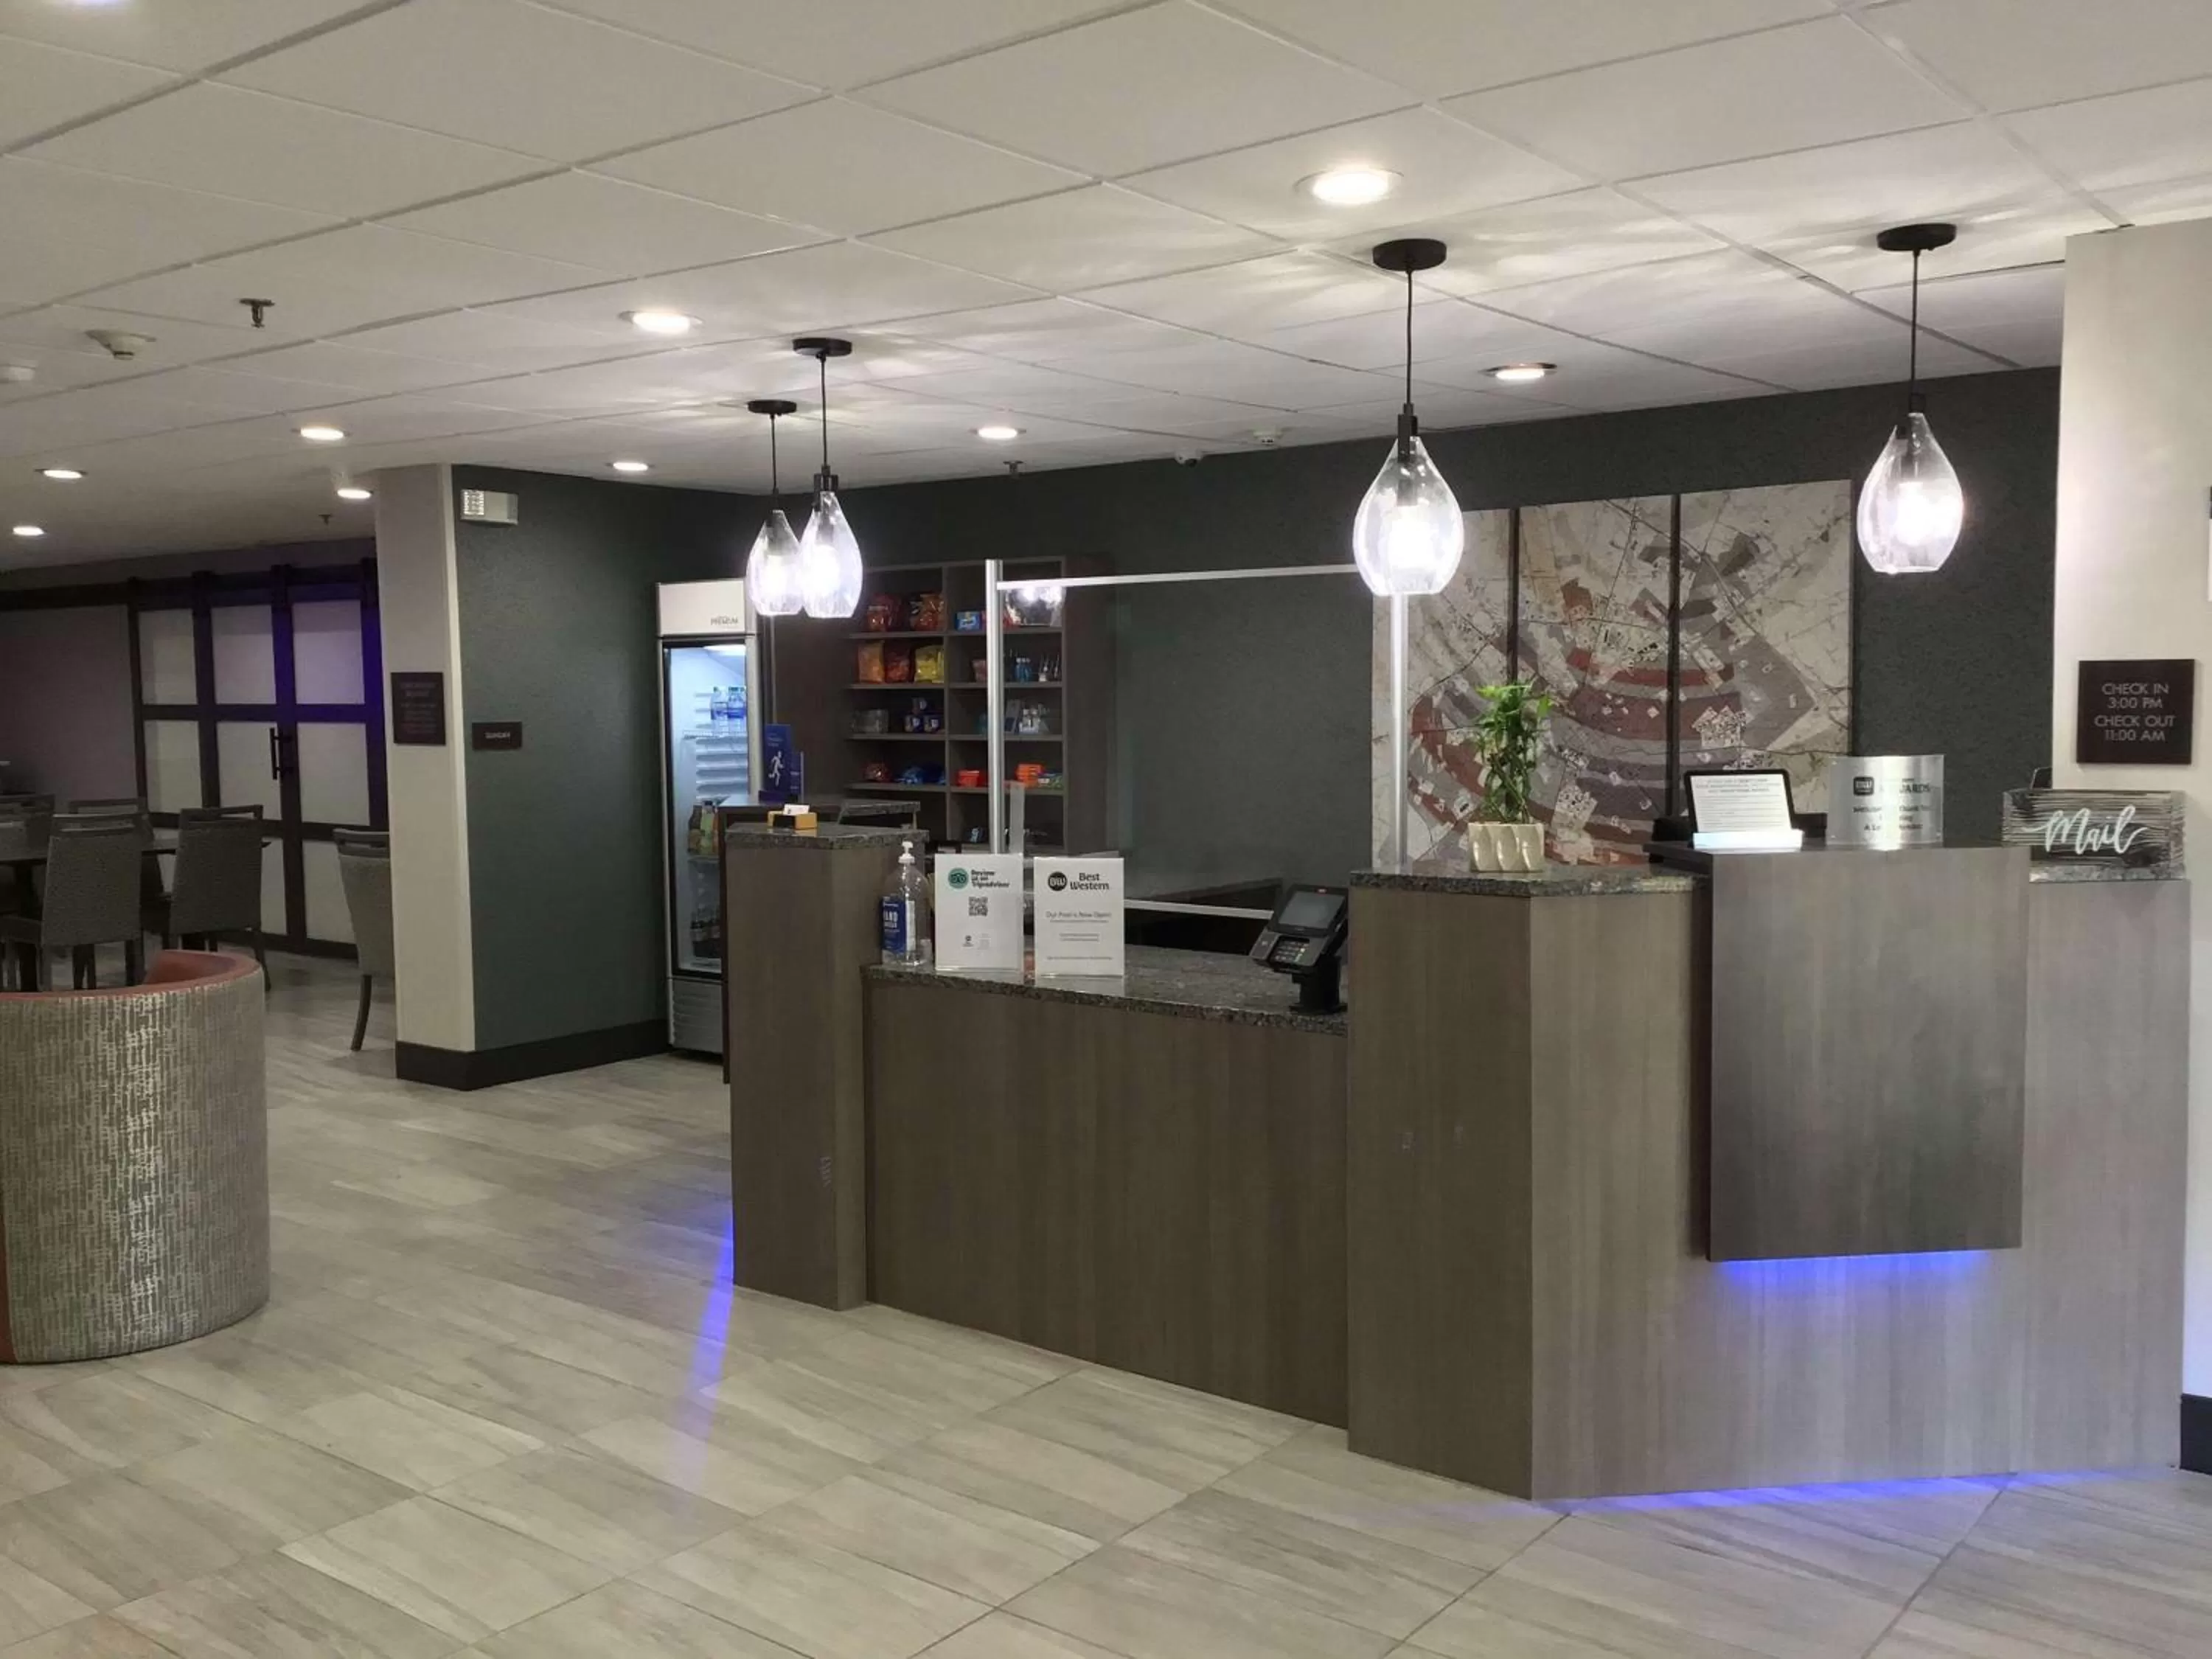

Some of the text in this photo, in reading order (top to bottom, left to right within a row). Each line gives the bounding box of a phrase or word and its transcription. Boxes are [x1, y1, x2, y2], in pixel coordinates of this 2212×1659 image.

[2101, 683, 2169, 695] CHECK IN
[2107, 696, 2163, 709] 3:00 PM
[2094, 714, 2177, 727] CHECK OUT
[2104, 729, 2166, 741] 11:00 AM
[2022, 804, 2147, 855] Mail
[1079, 872, 1099, 881] Best
[1070, 881, 1110, 890] Western
